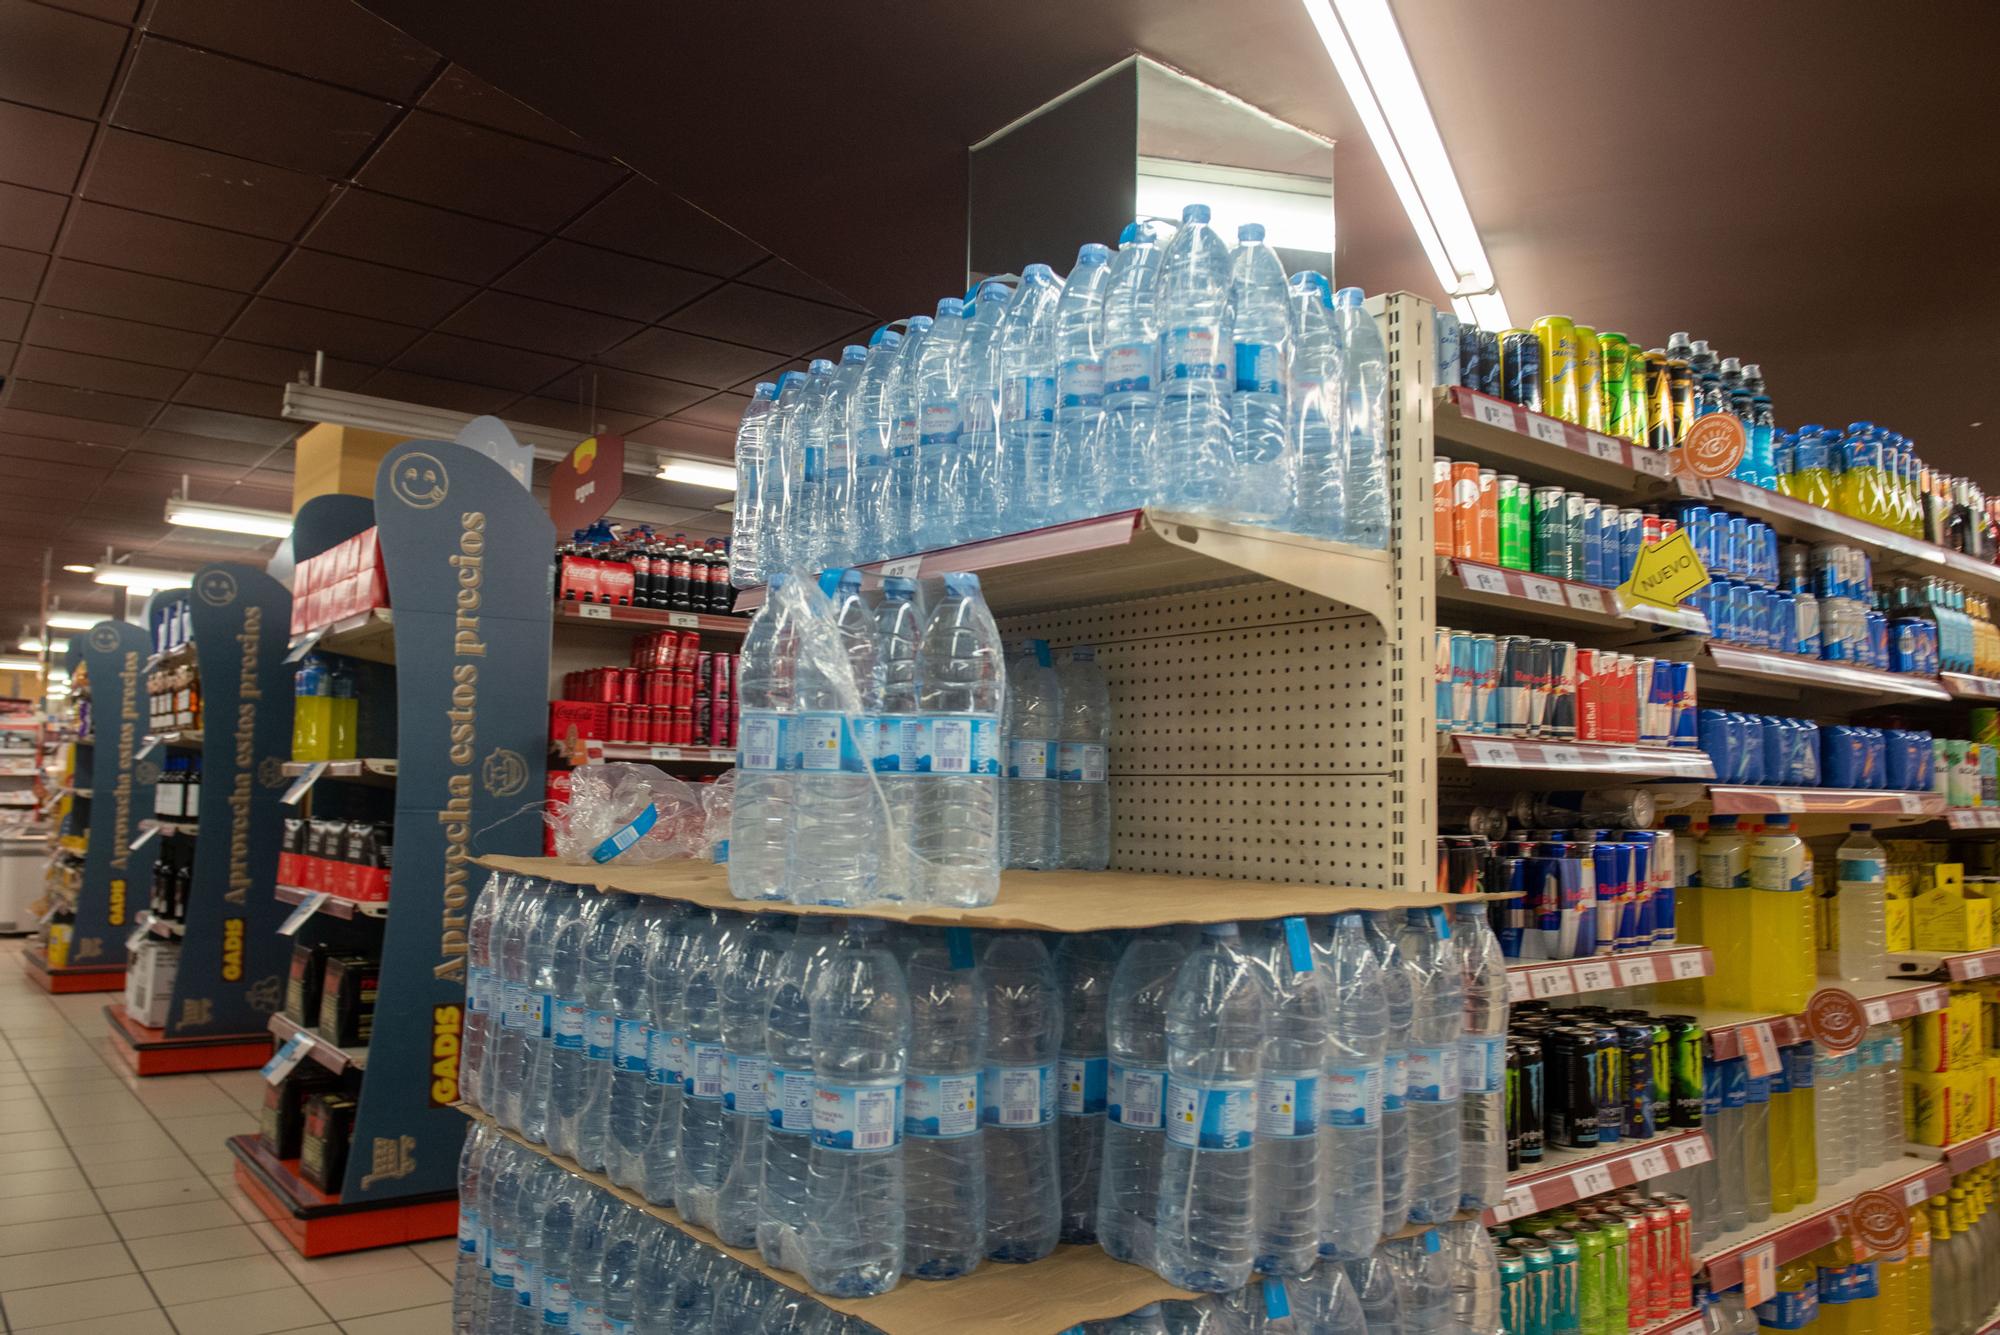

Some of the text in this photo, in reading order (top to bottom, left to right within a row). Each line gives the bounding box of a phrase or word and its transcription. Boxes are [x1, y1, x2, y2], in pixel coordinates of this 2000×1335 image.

[1640, 554, 1693, 592] NUEVO
[432, 511, 488, 981] Aprovecha estos precios
[1585, 702, 1597, 739] Red Bull
[110, 651, 139, 870] Aprovecha estos precios
[224, 606, 263, 906] Aprovecha estos precios
[976, 758, 991, 773] SAN
[109, 879, 125, 926] GADIS
[223, 918, 244, 982] GADIS
[432, 1005, 462, 1105] GADIS
[1222, 1132, 1239, 1149] SAN
